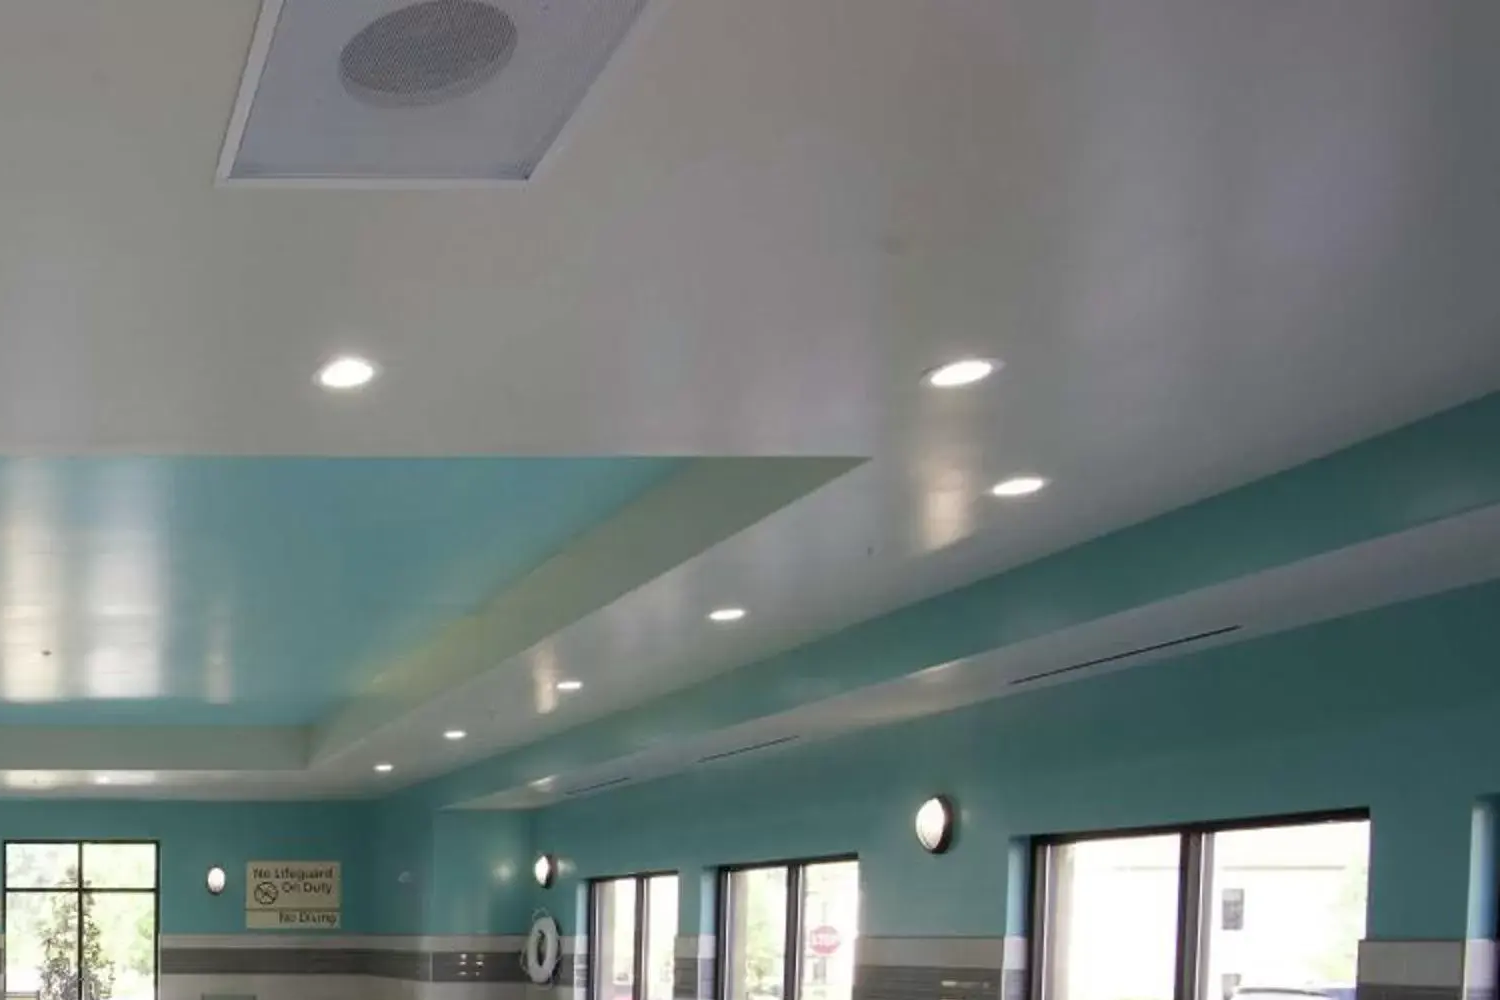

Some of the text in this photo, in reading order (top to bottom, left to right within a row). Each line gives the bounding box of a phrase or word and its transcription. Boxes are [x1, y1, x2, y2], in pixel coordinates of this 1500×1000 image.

[253, 867, 271, 879] No
[281, 881, 332, 895] On Duty
